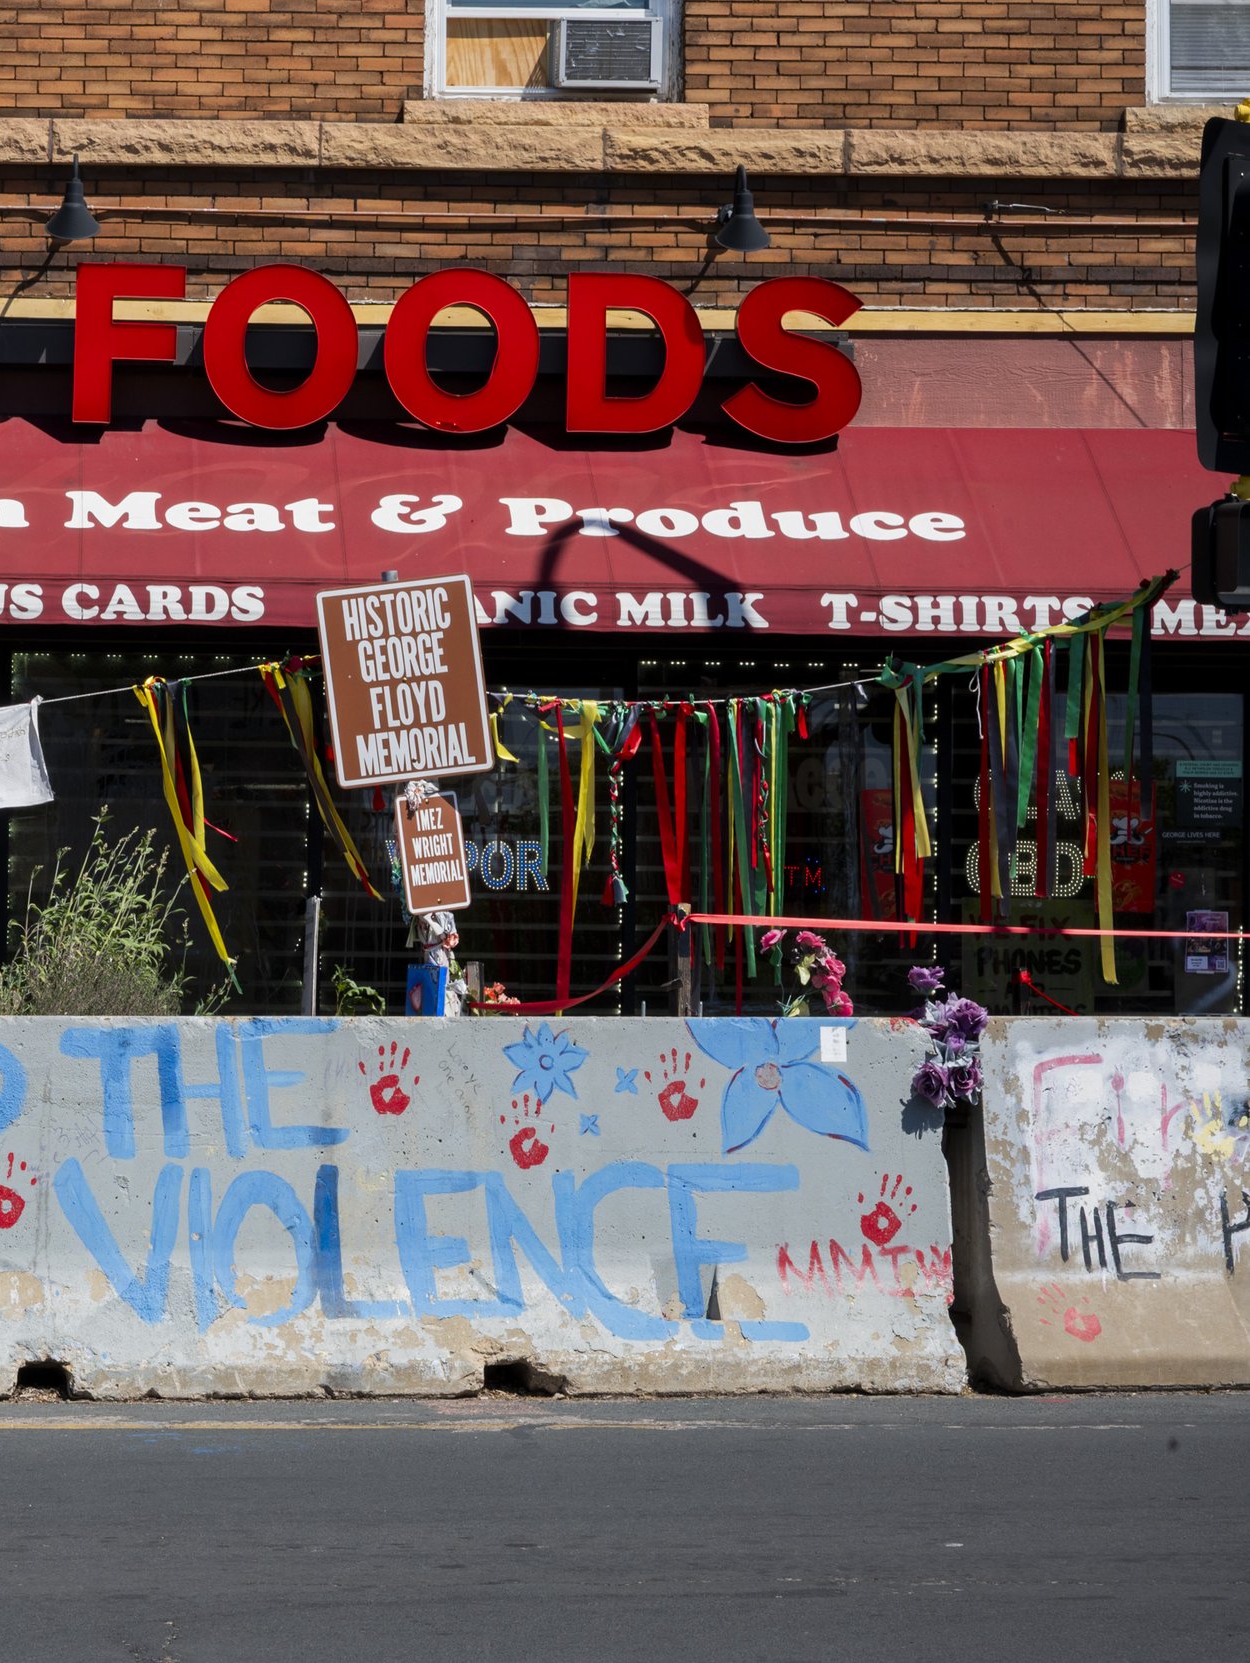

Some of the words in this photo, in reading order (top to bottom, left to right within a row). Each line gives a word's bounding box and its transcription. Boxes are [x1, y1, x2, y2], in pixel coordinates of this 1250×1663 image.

[72, 260, 863, 446] FOODS
[64, 490, 336, 533] Meat
[371, 494, 462, 534] &
[499, 498, 966, 541] Produce
[62, 583, 265, 622] CARDS
[615, 592, 769, 628] MILK
[820, 592, 1093, 632] T-SHIRTS
[342, 587, 451, 641] HISTORIC
[358, 633, 448, 683] GEORGE
[370, 680, 446, 729] FLOYD
[356, 722, 476, 777] MEMORIAL
[416, 807, 443, 831] IMEZ
[412, 833, 453, 859] WRIGHT
[411, 859, 464, 886] MEMORIAL
[784, 866, 822, 888] TM
[978, 948, 1082, 979] PHONES
[59, 1019, 351, 1161] THE
[53, 1156, 811, 1342] VIOLENCE
[1036, 1187, 1162, 1282] THE
[777, 1239, 954, 1300] MMIW
